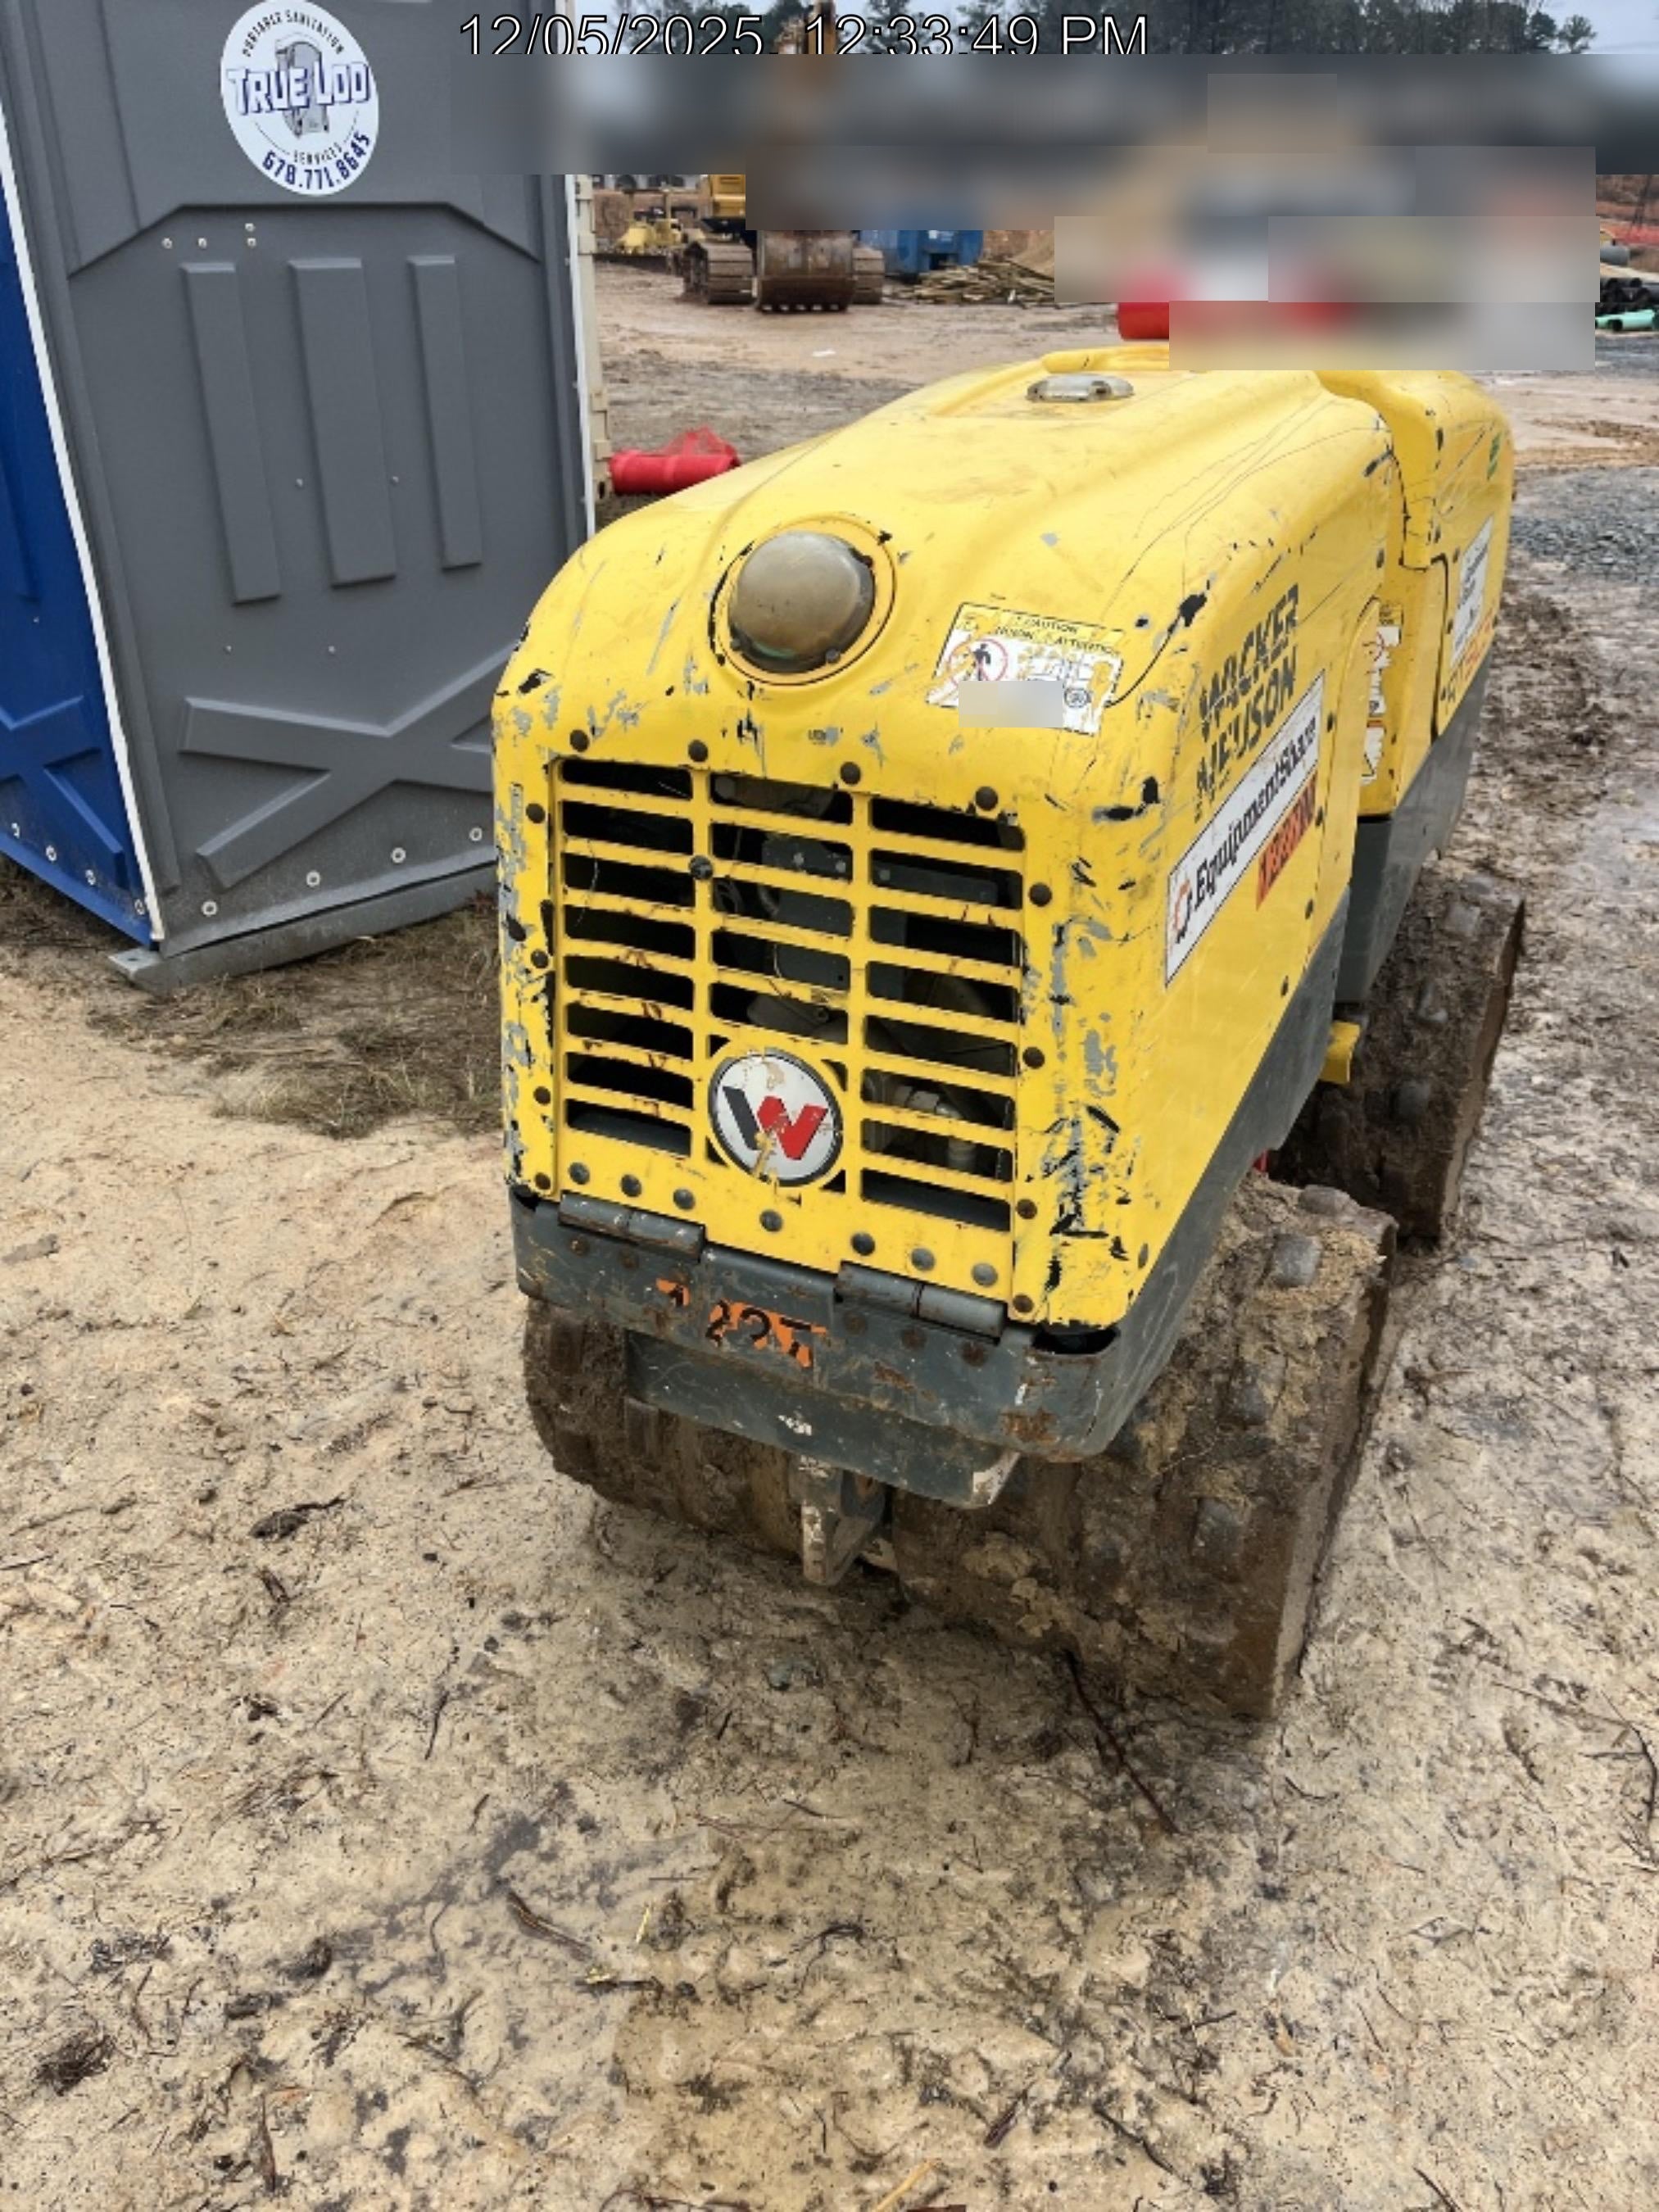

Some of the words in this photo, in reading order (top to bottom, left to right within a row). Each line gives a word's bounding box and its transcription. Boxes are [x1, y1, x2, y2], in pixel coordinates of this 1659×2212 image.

[226, 67, 310, 116] TRUE
[311, 61, 370, 107] LOO
[261, 130, 370, 191] 678.771.8645
[1199, 582, 1299, 742] WACKER
[1194, 642, 1297, 823] NEUSON
